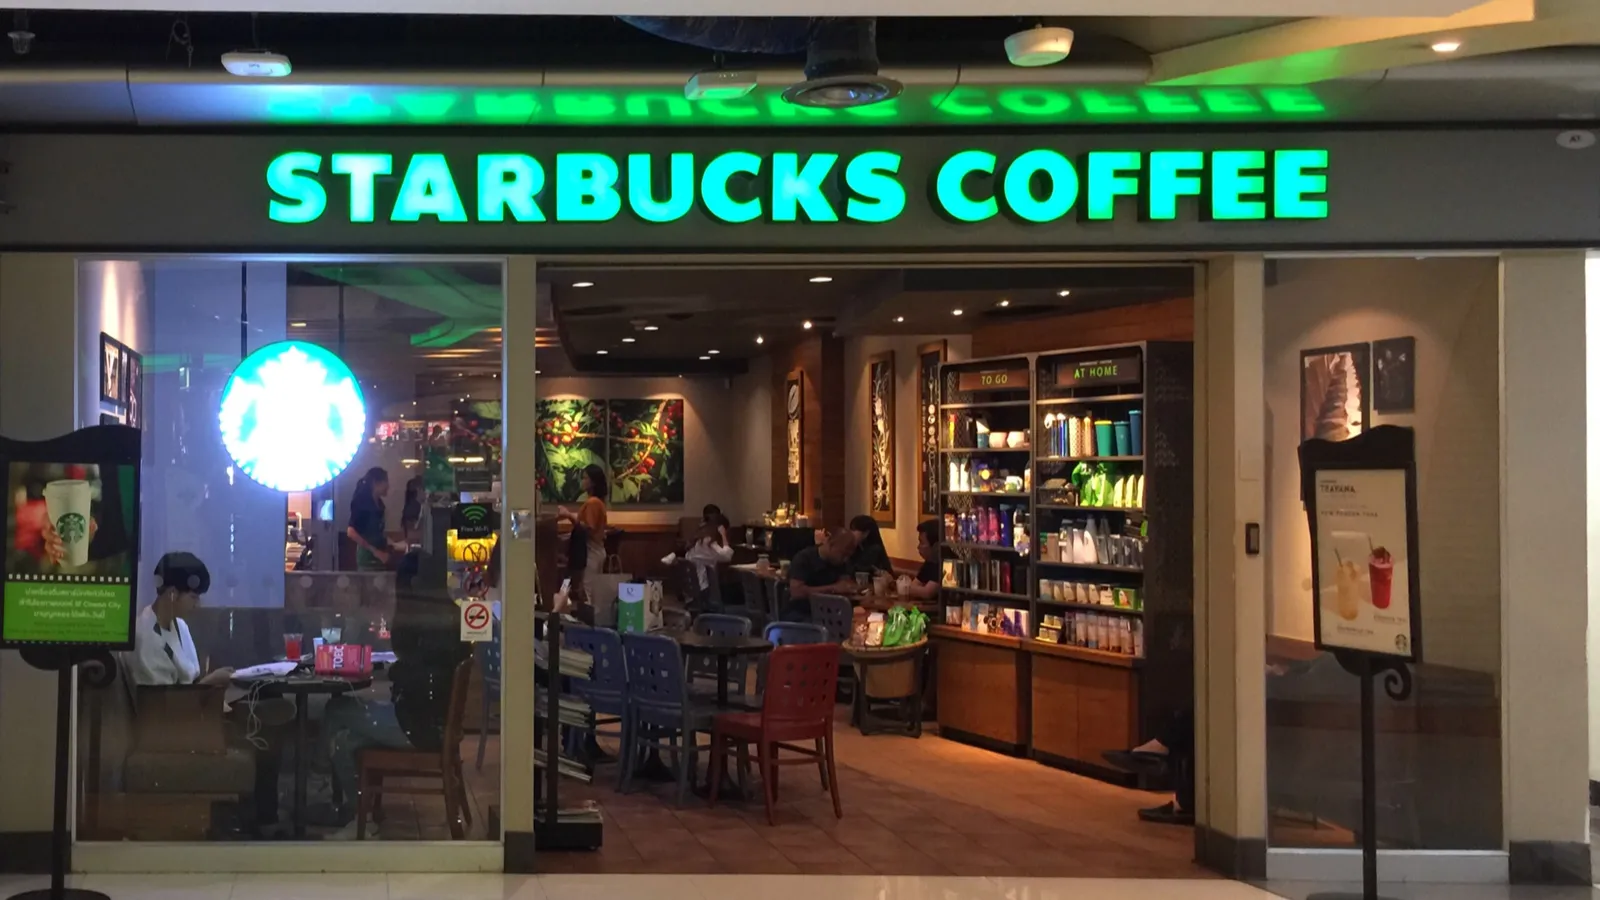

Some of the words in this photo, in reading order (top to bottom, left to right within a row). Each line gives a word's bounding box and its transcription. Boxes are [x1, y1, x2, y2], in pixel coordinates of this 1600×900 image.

[267, 151, 906, 223] STARBUCKS
[937, 149, 1329, 222] COFFEE
[1074, 367, 1086, 379] AT
[1089, 365, 1118, 377] HOME
[981, 375, 993, 386] TO
[995, 374, 1008, 384] GO
[108, 602, 121, 610] City
